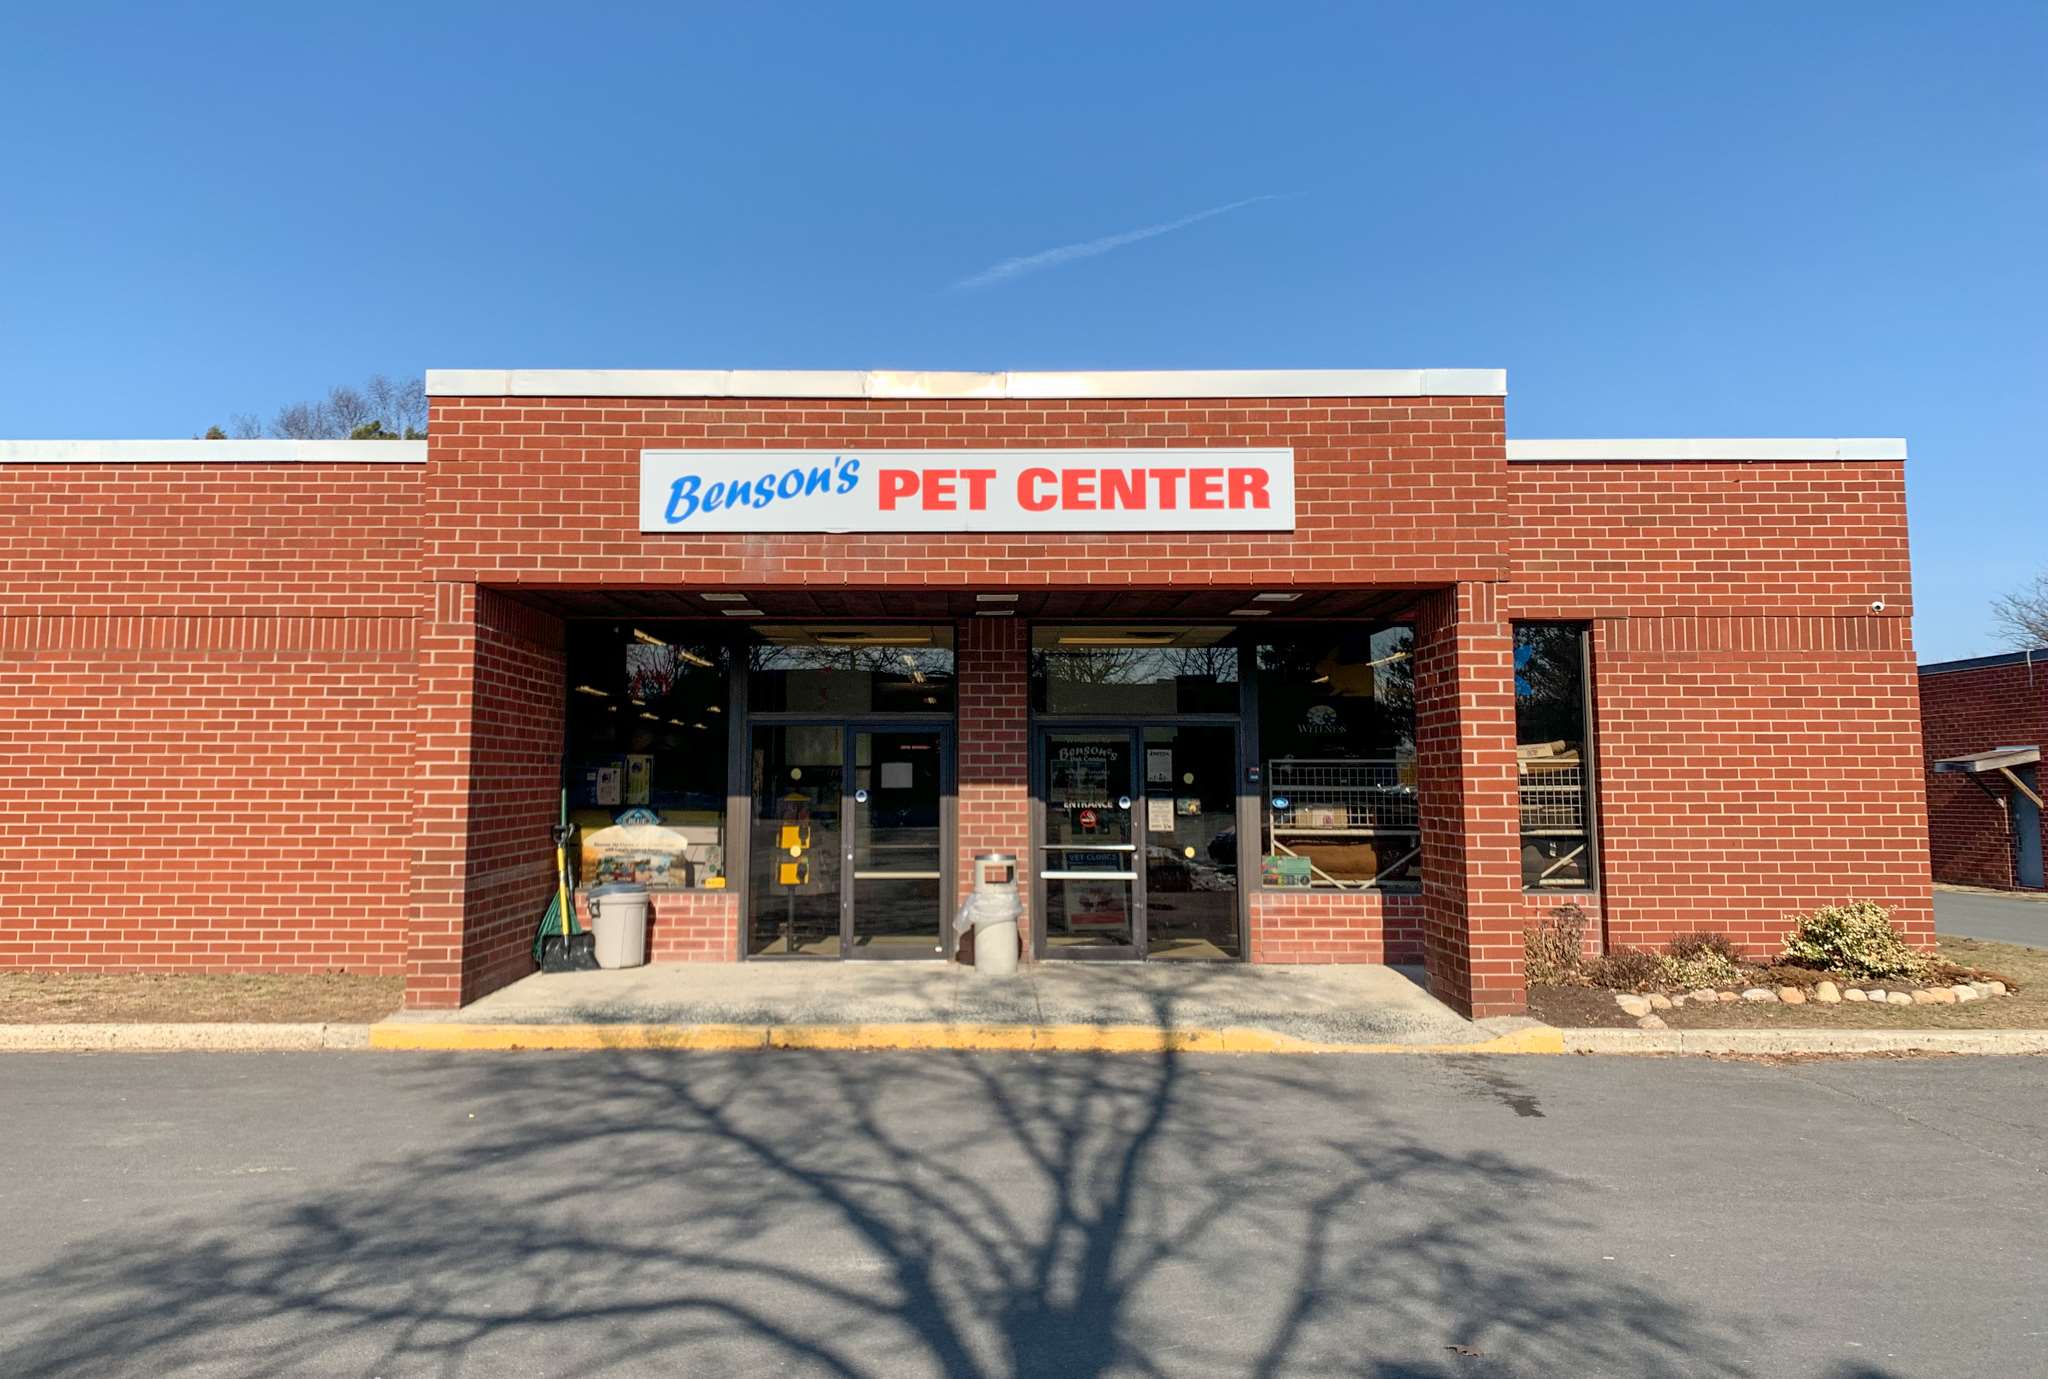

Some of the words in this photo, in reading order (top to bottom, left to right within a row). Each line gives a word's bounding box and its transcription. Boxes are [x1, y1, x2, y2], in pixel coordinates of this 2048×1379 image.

[663, 456, 860, 524] Benson's
[878, 468, 997, 510] PET
[1016, 467, 1270, 511] CENTER
[1063, 799, 1114, 809] ENTRANCE
